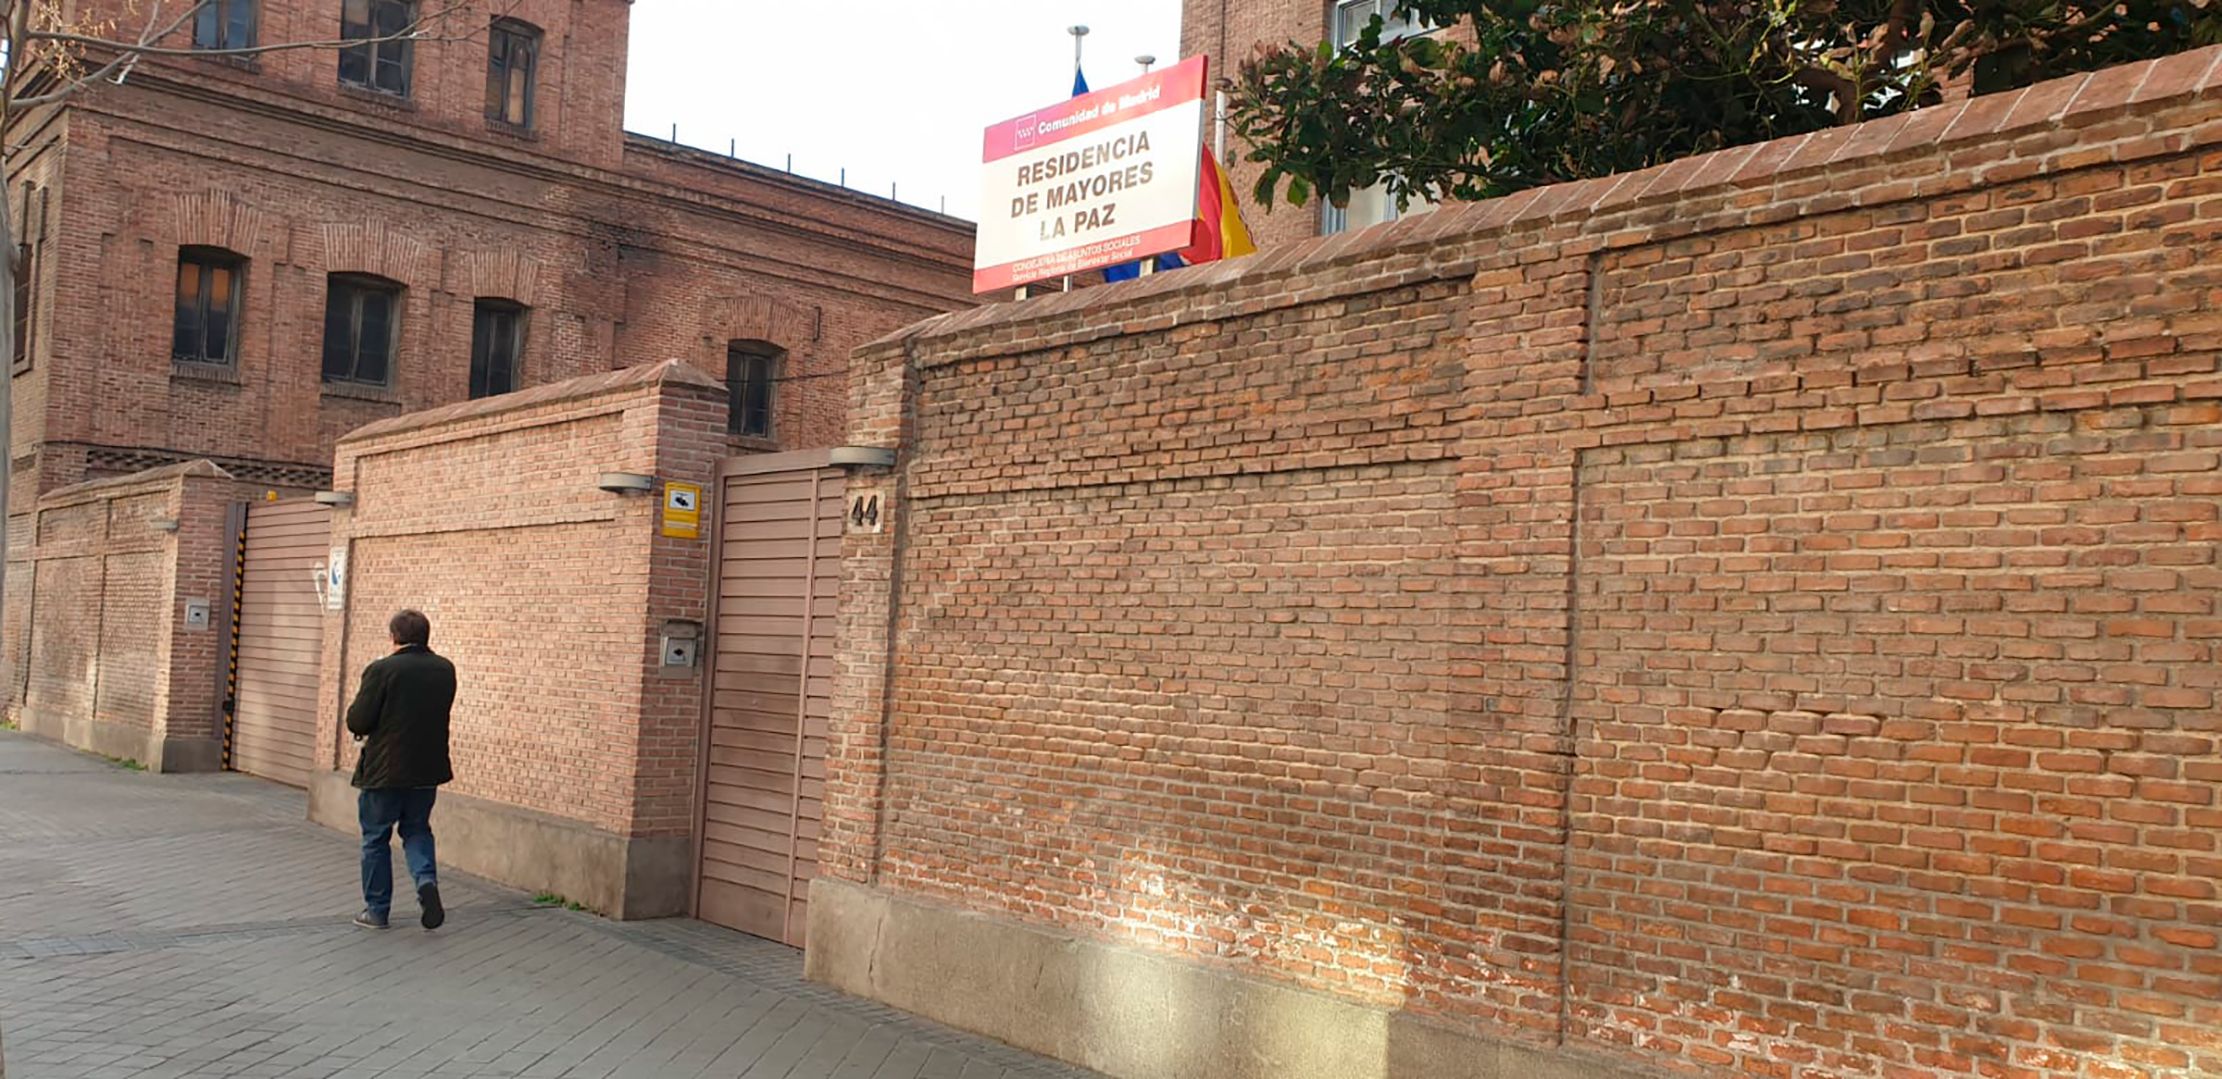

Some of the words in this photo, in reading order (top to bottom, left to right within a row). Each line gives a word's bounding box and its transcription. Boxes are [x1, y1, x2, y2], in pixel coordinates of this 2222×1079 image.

[1038, 105, 1099, 134] Comunidad
[1101, 101, 1116, 116] de
[1118, 84, 1161, 110] Madrid
[1017, 130, 1150, 187] RESIDENCIA
[1011, 192, 1039, 219] DE
[1046, 161, 1154, 210] MAYORES
[1040, 216, 1066, 241] LA
[1074, 203, 1116, 233] PAZ
[1103, 235, 1141, 253] SOCIALES
[851, 494, 878, 527] 44
